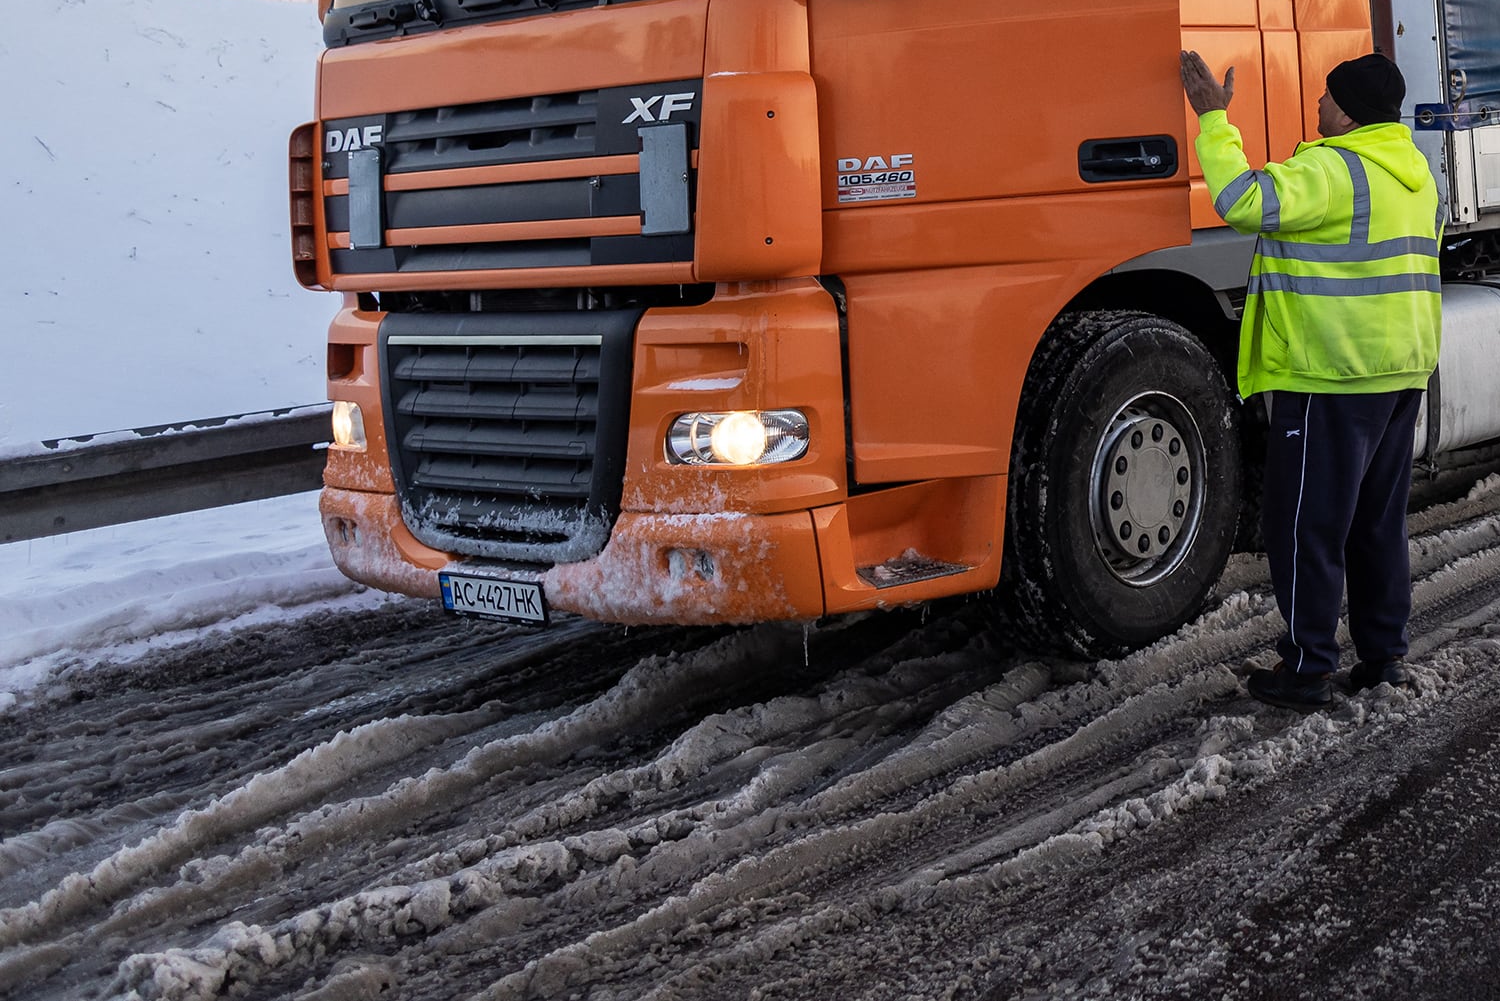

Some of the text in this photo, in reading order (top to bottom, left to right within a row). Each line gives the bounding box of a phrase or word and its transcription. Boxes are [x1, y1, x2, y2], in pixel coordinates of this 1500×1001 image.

[621, 92, 696, 124] XF
[326, 125, 382, 153] DAF
[838, 153, 913, 172] DAF
[840, 171, 912, 185] 105.460
